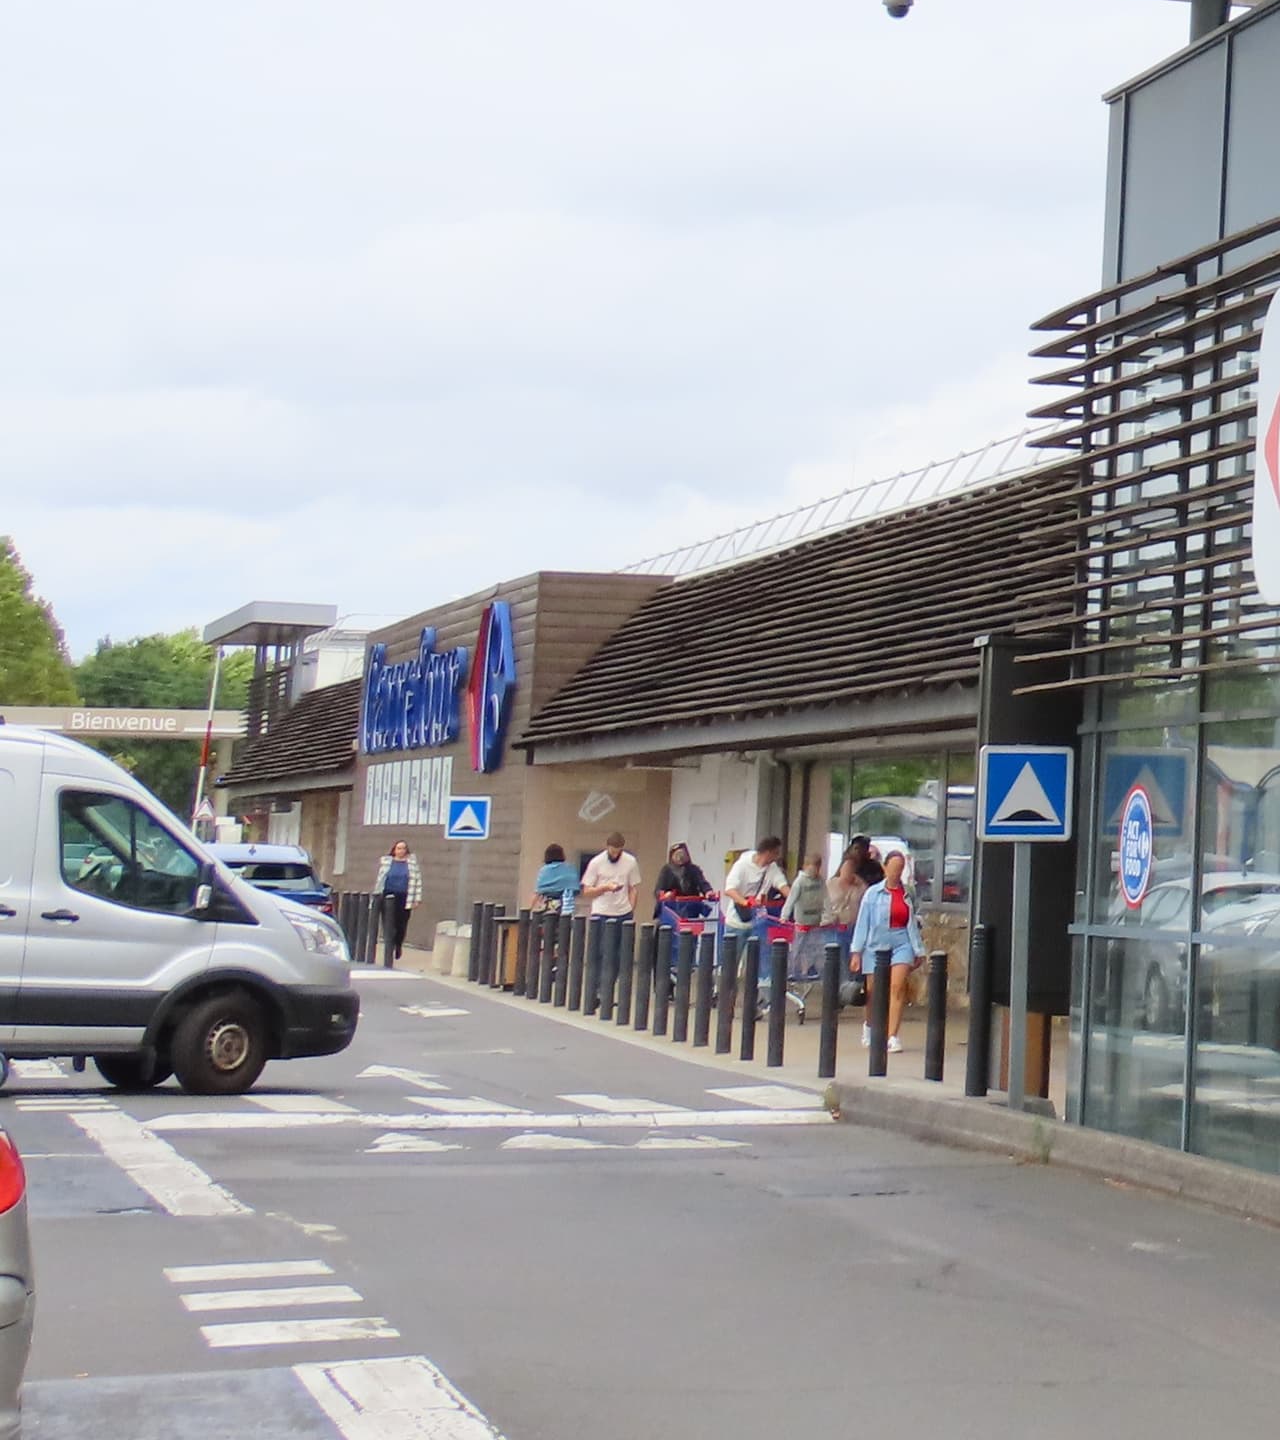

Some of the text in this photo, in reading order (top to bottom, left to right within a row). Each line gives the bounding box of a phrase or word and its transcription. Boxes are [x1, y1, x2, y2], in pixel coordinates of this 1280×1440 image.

[71, 712, 177, 731] Bienvenue
[1127, 820, 1140, 840] ACT
[1125, 841, 1138, 858] FOR
[1124, 859, 1141, 877] FOOD
